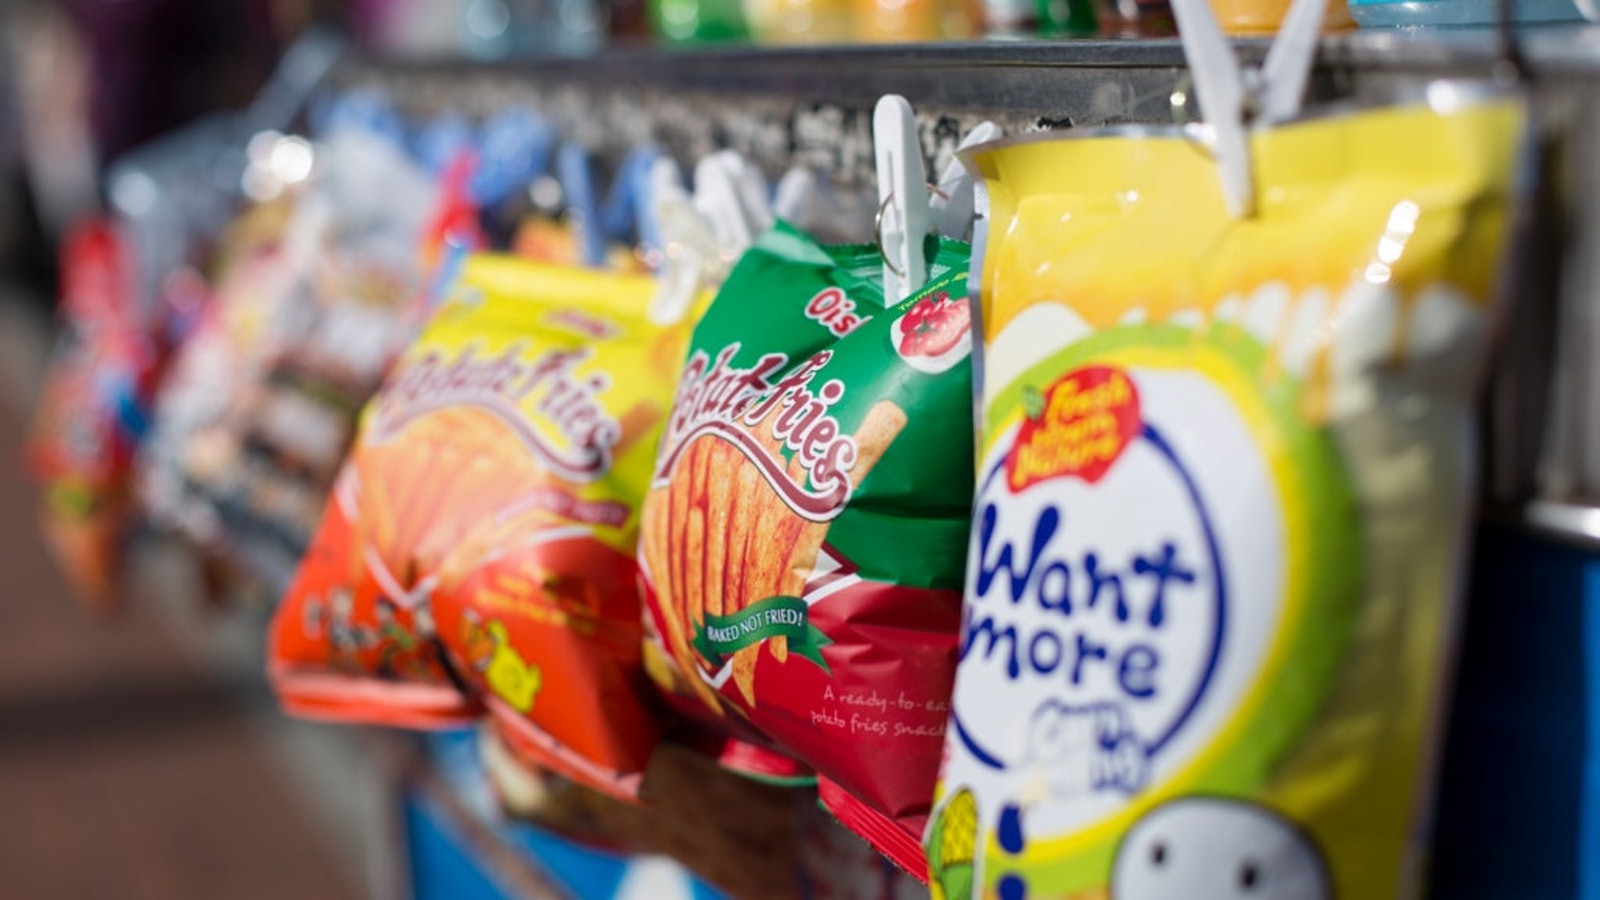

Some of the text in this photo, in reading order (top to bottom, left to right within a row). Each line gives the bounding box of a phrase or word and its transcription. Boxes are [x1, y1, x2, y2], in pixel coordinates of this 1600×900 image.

[805, 287, 873, 339] Ois
[975, 502, 1195, 628] Want
[707, 609, 803, 642] BAKED NOT FRIED!
[959, 604, 1157, 698] more
[823, 684, 949, 713] A ready-to-ea
[810, 707, 846, 729] potato
[851, 712, 889, 736] fries
